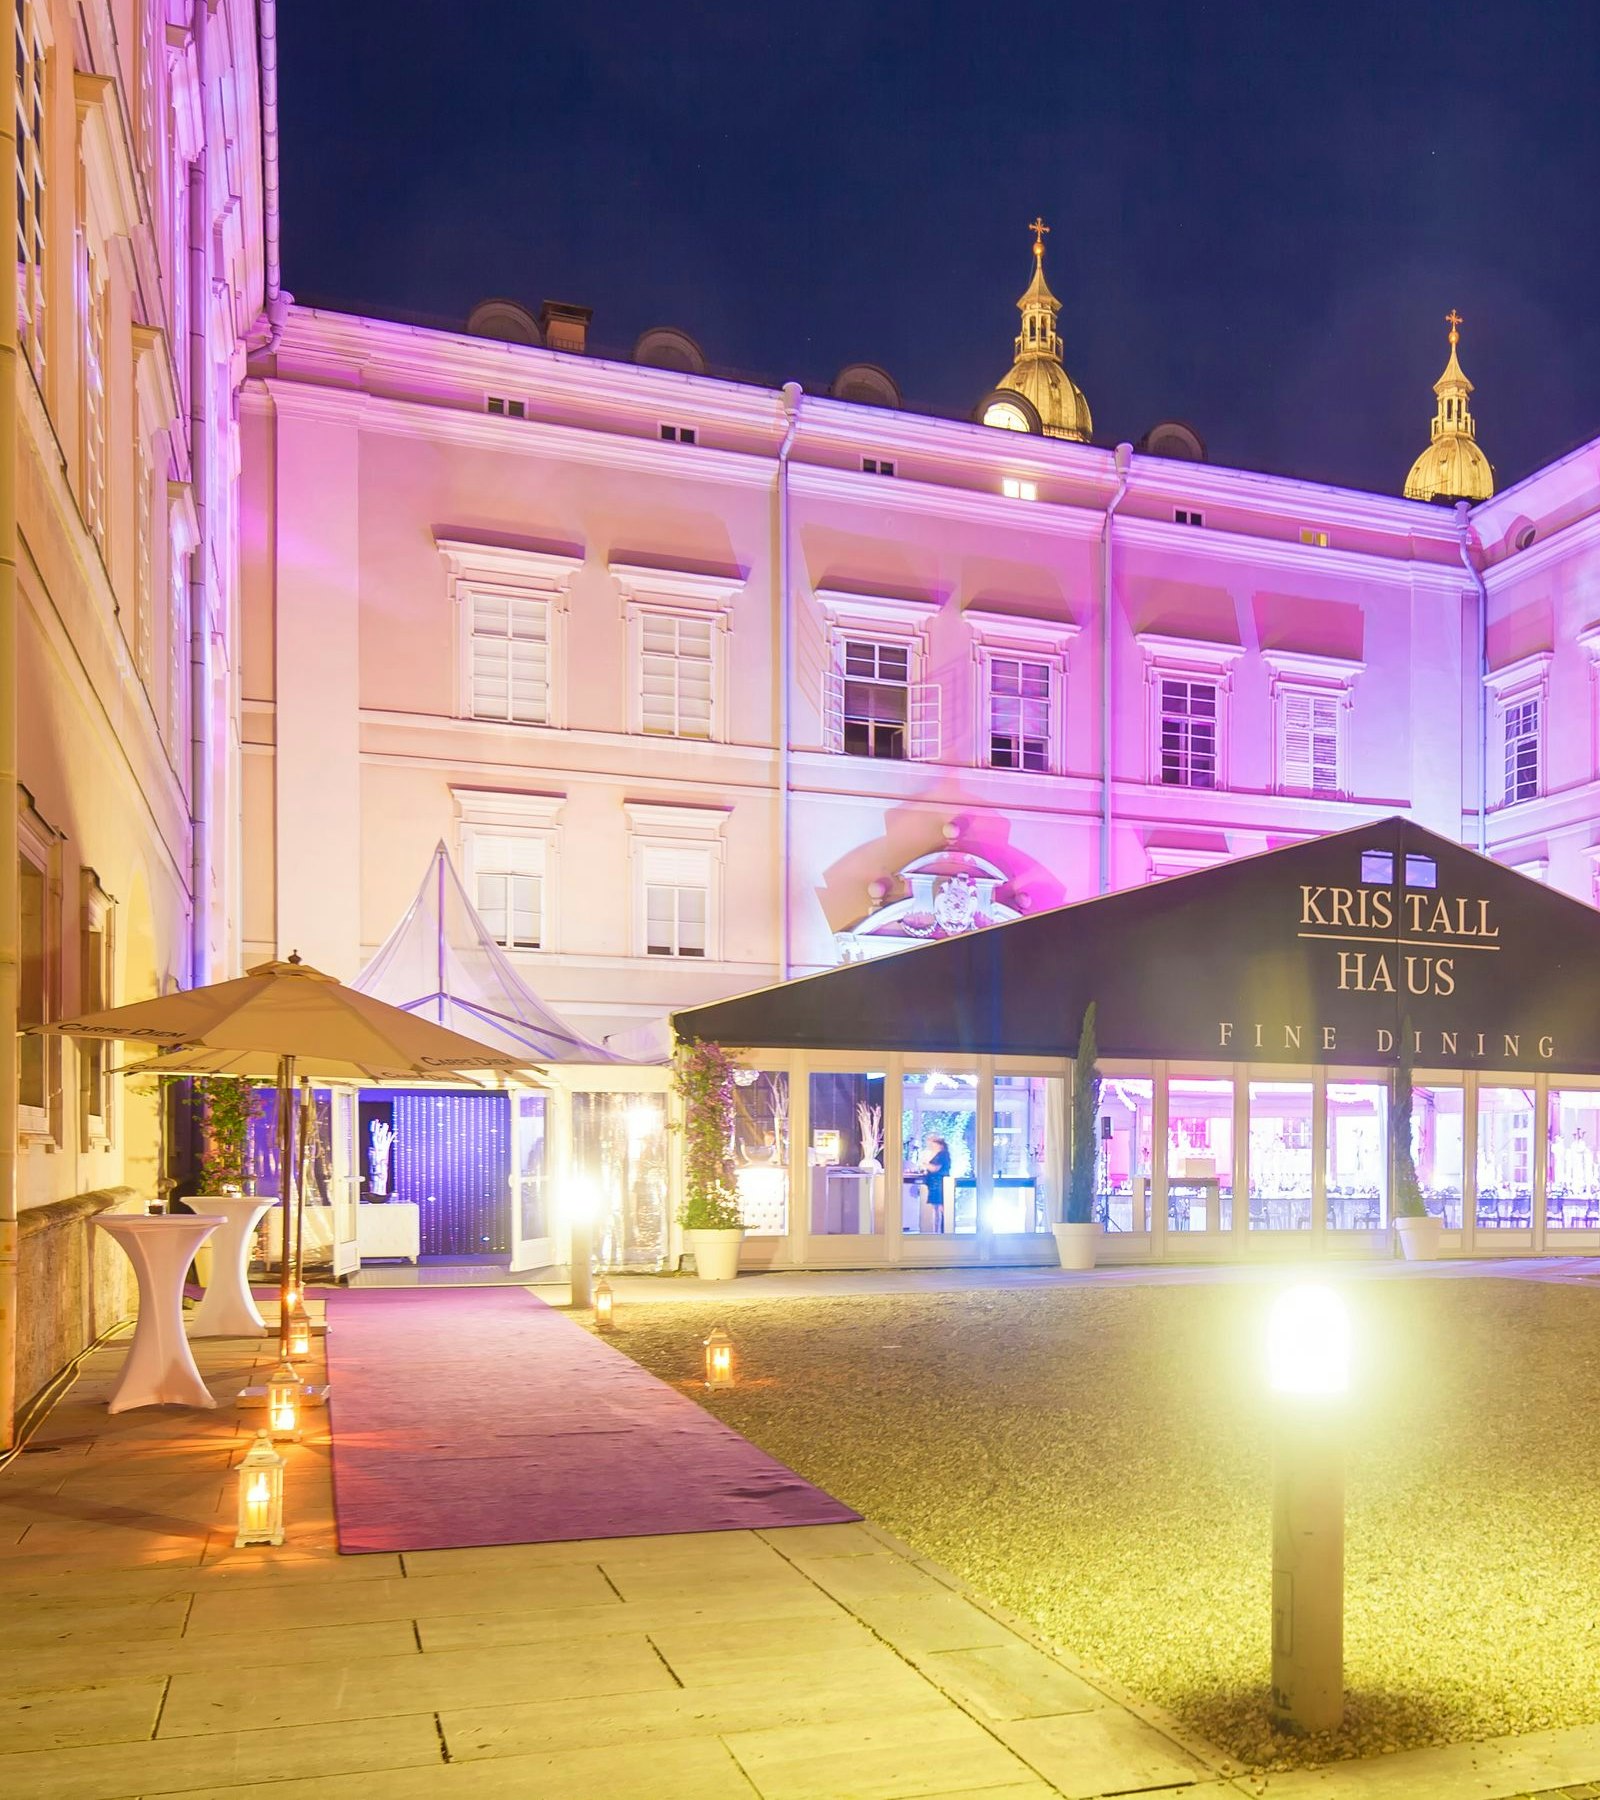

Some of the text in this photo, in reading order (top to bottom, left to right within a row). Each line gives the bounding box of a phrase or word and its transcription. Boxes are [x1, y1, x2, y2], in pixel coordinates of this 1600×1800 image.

[1336, 951, 1456, 996] HAUS
[57, 1023, 187, 1039] CARPE DIEM
[1218, 1022, 1555, 1058] FINE DINING
